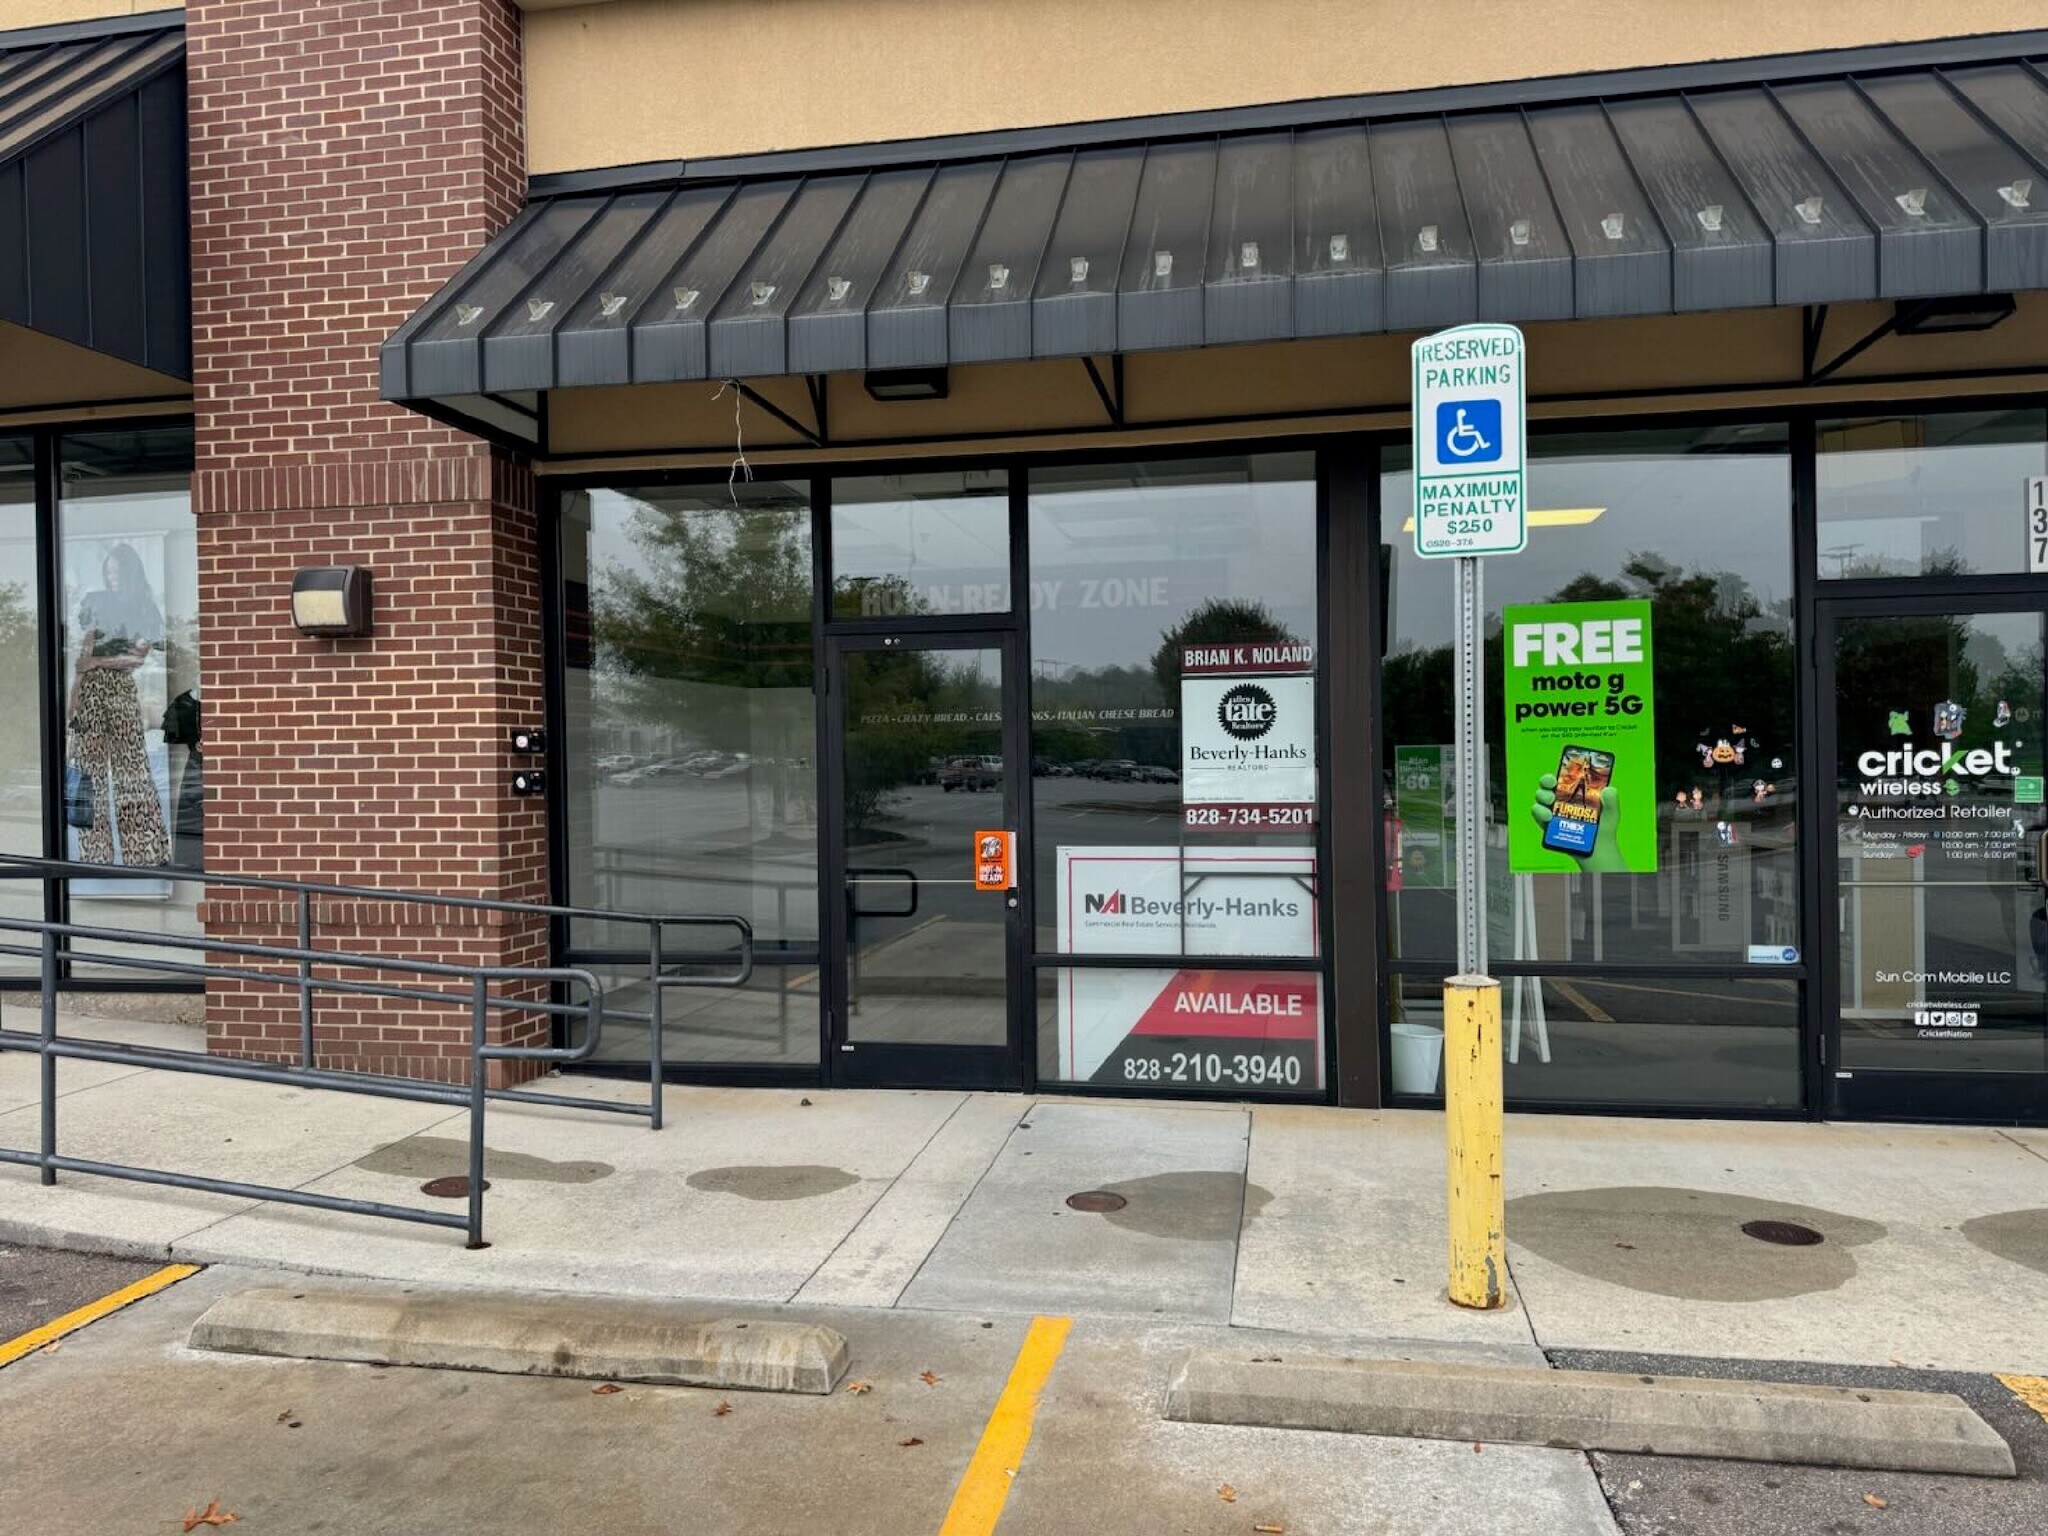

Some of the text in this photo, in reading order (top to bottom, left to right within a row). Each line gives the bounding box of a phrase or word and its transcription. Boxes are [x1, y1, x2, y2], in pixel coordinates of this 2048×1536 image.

[1421, 337, 1515, 363] RESERVED
[1426, 364, 1511, 388] PARKING
[1422, 480, 1517, 501] MAXIMUM
[1423, 498, 1516, 518] PENALTY
[1447, 519, 1493, 535] $250
[1080, 577, 1169, 609] ZONE
[1513, 618, 1644, 667] FREE
[1184, 646, 1313, 667] BRIAN K. NOLAND
[1532, 672, 1625, 694] moto g
[897, 714, 930, 723] CRAZY
[933, 713, 967, 722] BREAD
[1057, 710, 1096, 720] ITALIAN
[1099, 709, 1137, 719] CHEESE
[1138, 708, 1174, 718] BREAD
[1223, 696, 1273, 721] tate
[1515, 695, 1644, 723] power 5G
[1190, 744, 1307, 765] Beverly-Hanks
[1858, 741, 2011, 777] cricket
[1860, 779, 1942, 796] wireless
[1186, 808, 1313, 825] 828-734-5201
[1858, 805, 2012, 819] Authorized Retailer
[1717, 851, 1730, 922] SAMSUNG
[1085, 888, 1299, 920] NAI Beverly-Hanks
[1875, 970, 2011, 984] Sun Com Mobile LLC
[1174, 992, 1302, 1016] AVAILABLE
[1124, 1052, 1301, 1085] 828-210-3940
